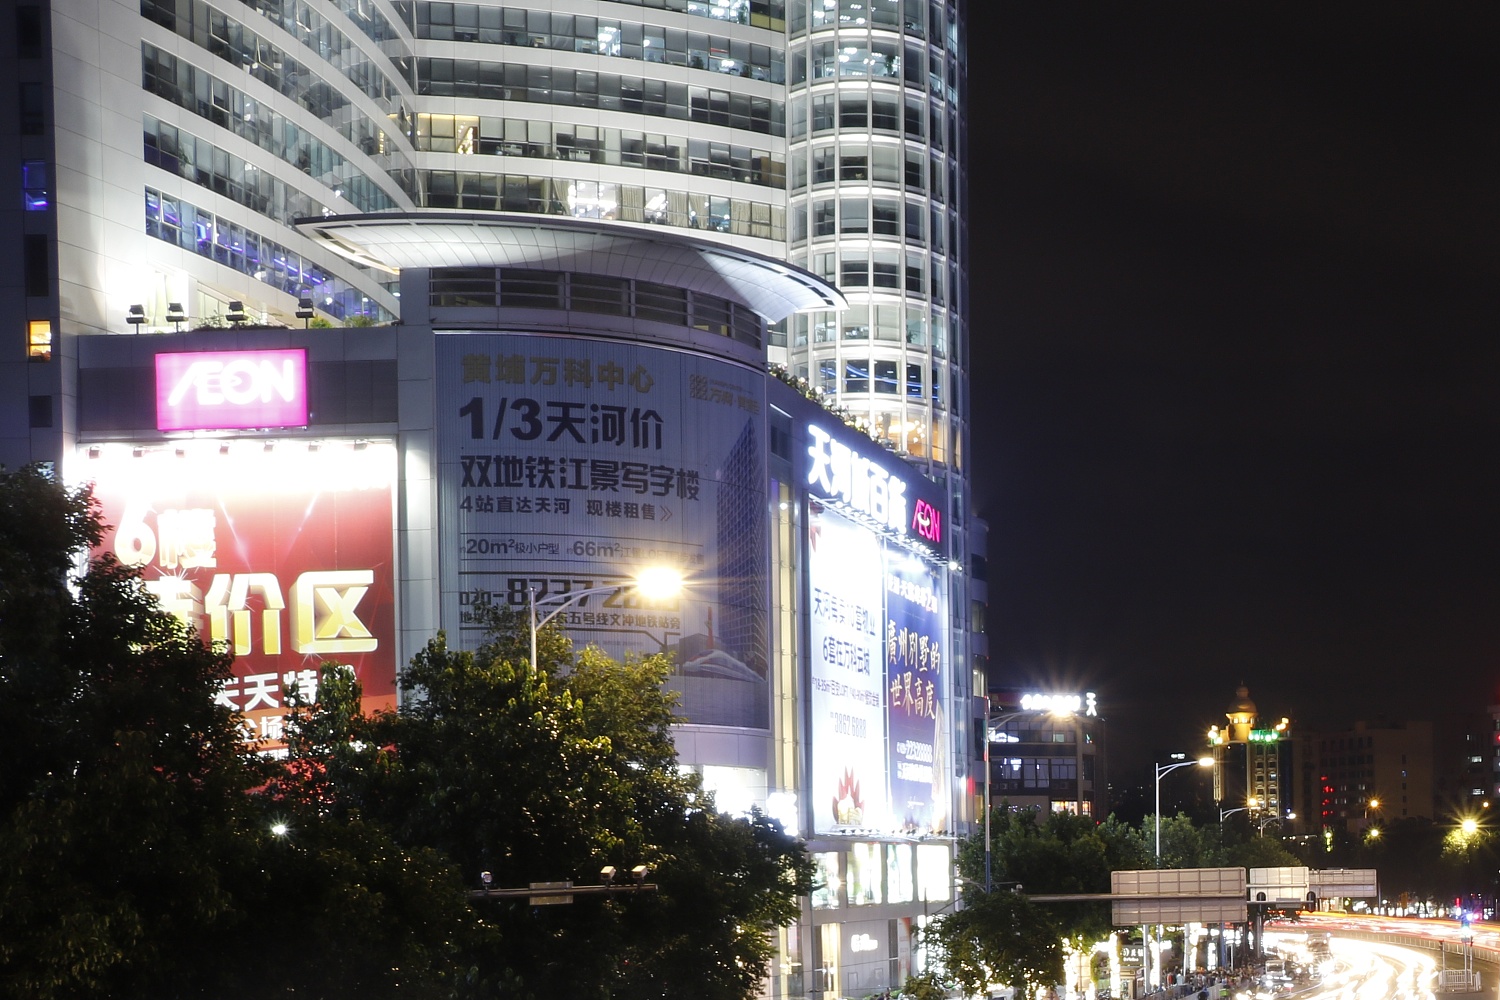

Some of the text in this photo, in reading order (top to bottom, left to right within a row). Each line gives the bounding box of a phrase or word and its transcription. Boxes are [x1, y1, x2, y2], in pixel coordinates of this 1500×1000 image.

[460, 354, 655, 394] 黄埔万科中心
[459, 397, 663, 450] 1/3天河价
[460, 455, 699, 501] 双地铁江景写字楼
[808, 424, 906, 534] 天河城百货
[459, 495, 656, 521] 4站直达天河 现楼租售
[114, 500, 216, 568] 6楼
[890, 671, 935, 720] 世界高度
